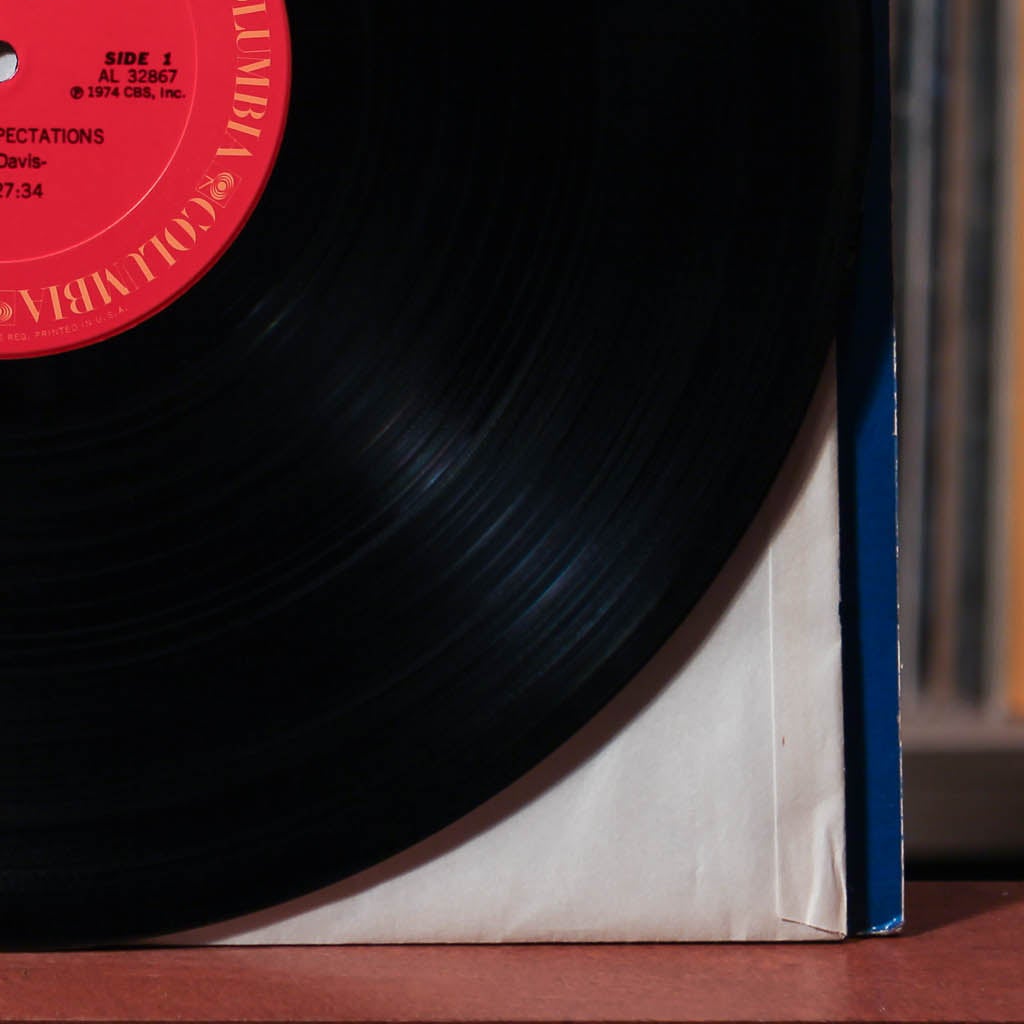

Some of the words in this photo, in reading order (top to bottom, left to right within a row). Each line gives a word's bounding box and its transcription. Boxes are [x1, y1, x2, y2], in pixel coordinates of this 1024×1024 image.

[104, 51, 150, 66] SIDE
[162, 52, 171, 66] 1
[98, 68, 120, 83] AL
[127, 68, 178, 84] 32867
[88, 85, 120, 98] 1974
[123, 86, 156, 100] CBS,
[160, 87, 185, 99] Inc.
[18, 197, 216, 324] COLUMBIA
